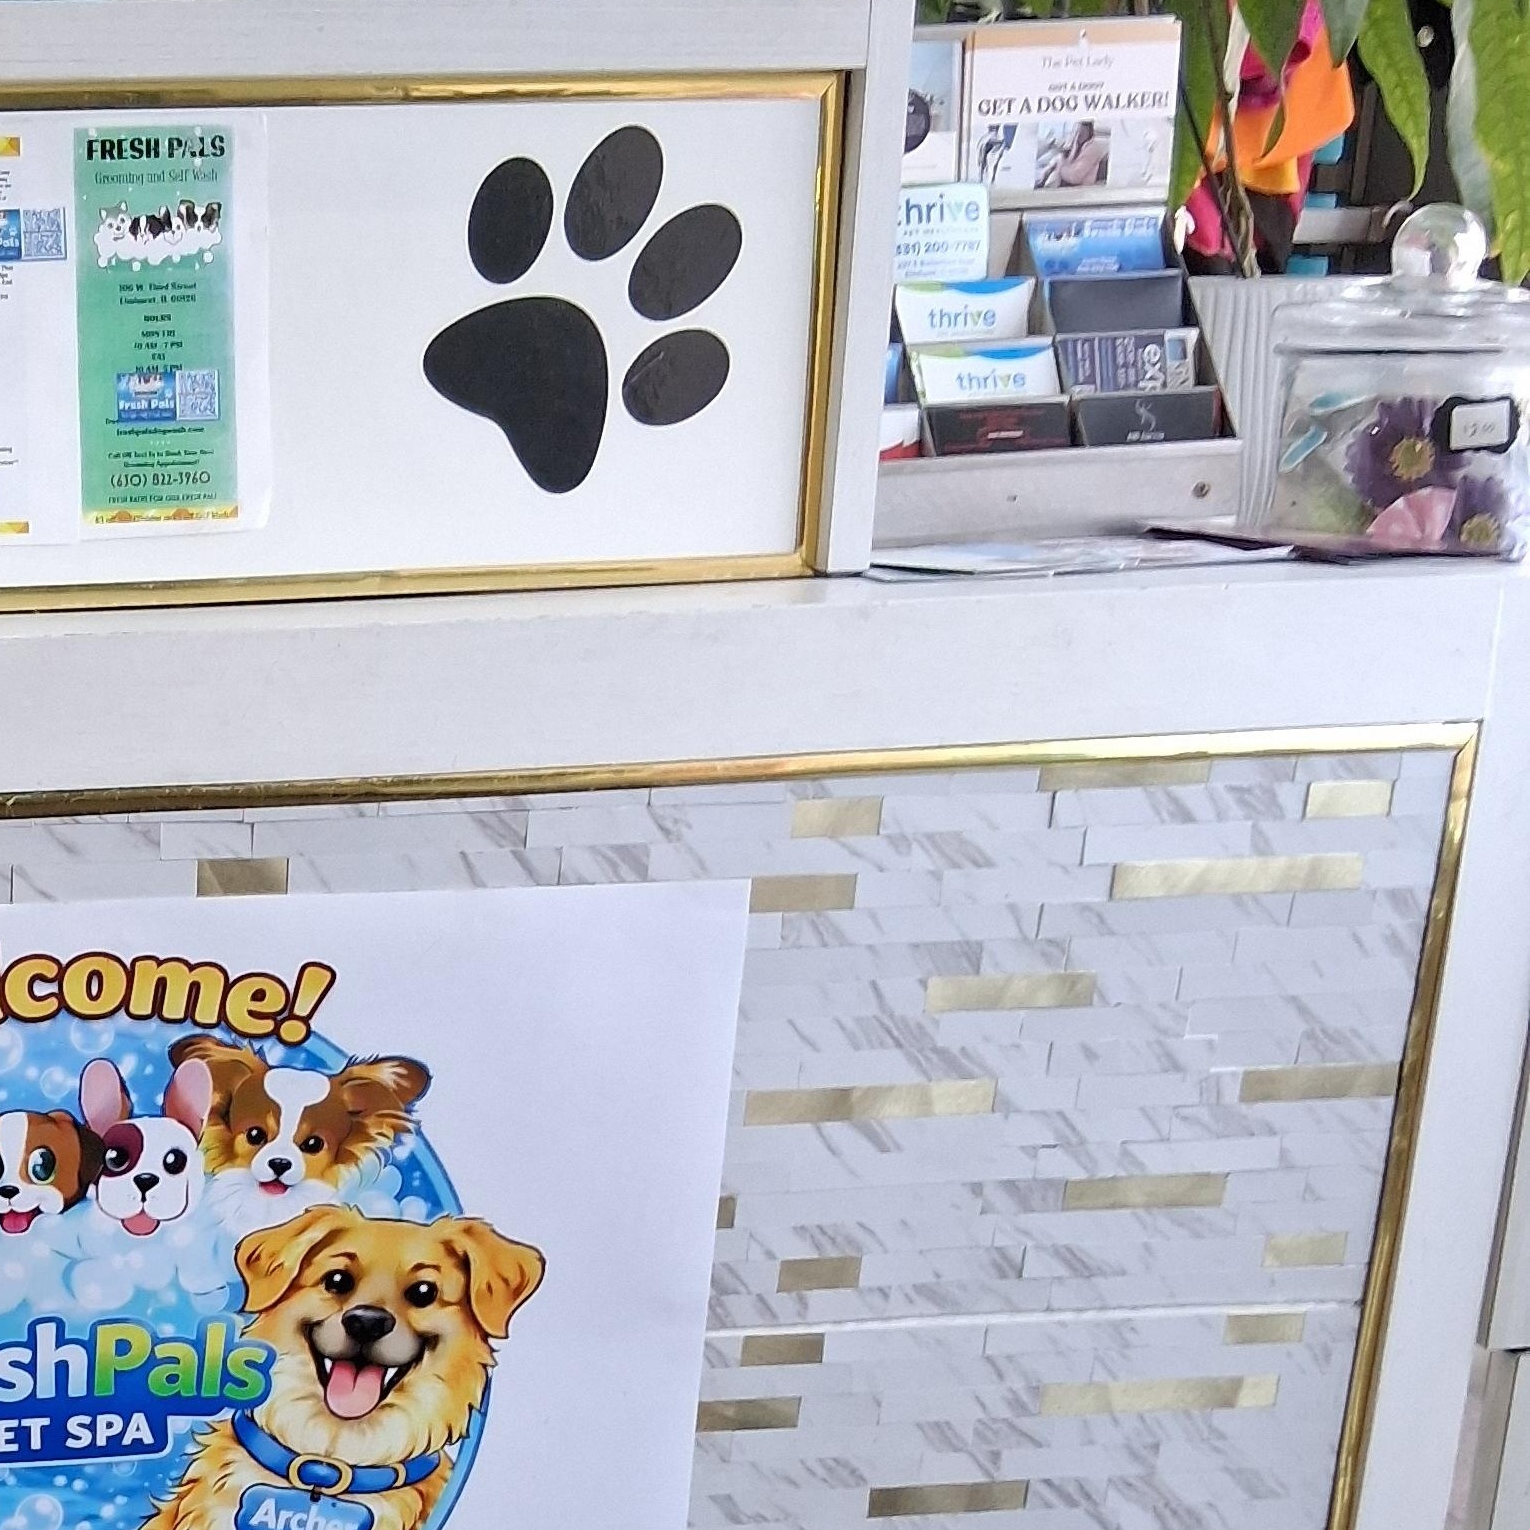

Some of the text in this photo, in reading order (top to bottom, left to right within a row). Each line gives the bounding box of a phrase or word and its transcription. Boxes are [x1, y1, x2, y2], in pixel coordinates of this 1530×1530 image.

[978, 90, 1169, 116] GET A DOG WALKER!
[86, 135, 225, 161] FRESH PALS
[95, 168, 218, 186] Grooming and Self Wash
[898, 193, 980, 225] hrive
[929, 304, 996, 328] thrive
[956, 368, 1026, 391] thrive
[111, 471, 210, 488] (630) 822-3960
[65, 1412, 155, 1449] SPA
